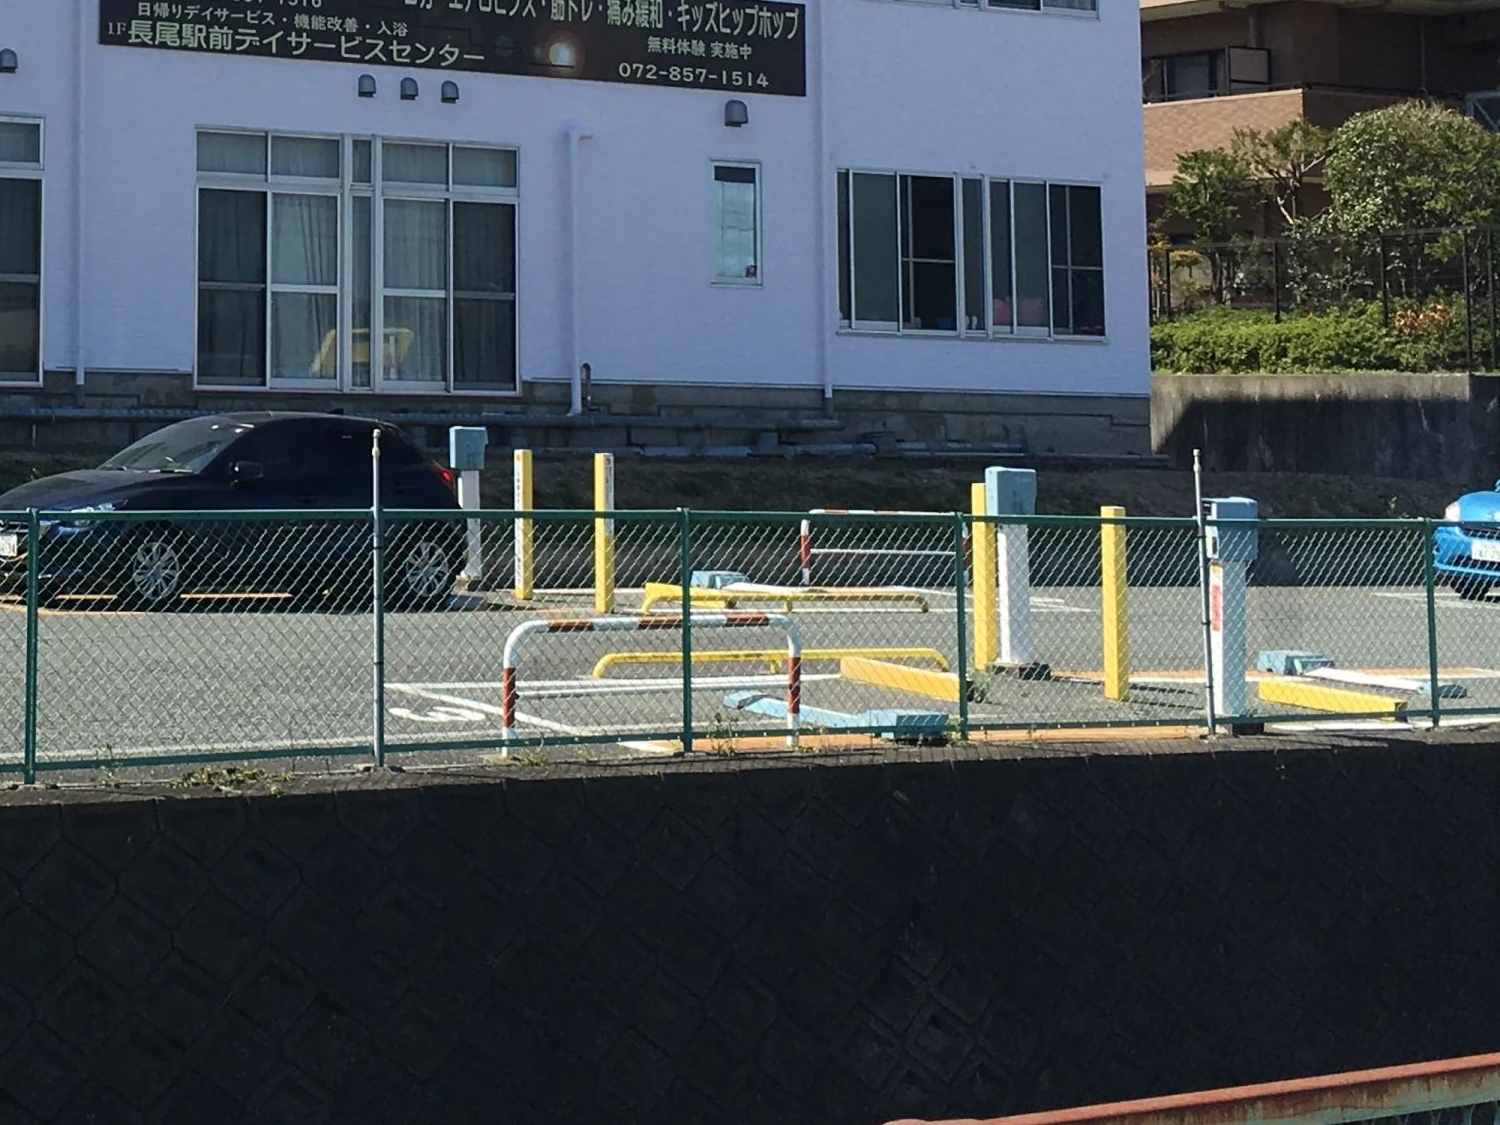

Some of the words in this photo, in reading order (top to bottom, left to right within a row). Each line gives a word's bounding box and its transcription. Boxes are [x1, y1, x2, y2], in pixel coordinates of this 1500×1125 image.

[107, 21, 127, 35] 1F
[127, 19, 485, 66] 長尾駅前デイサービスセンター
[647, 36, 706, 57] 無料体験
[710, 41, 752, 61] 実施中
[618, 62, 770, 89] 072-857-1514
